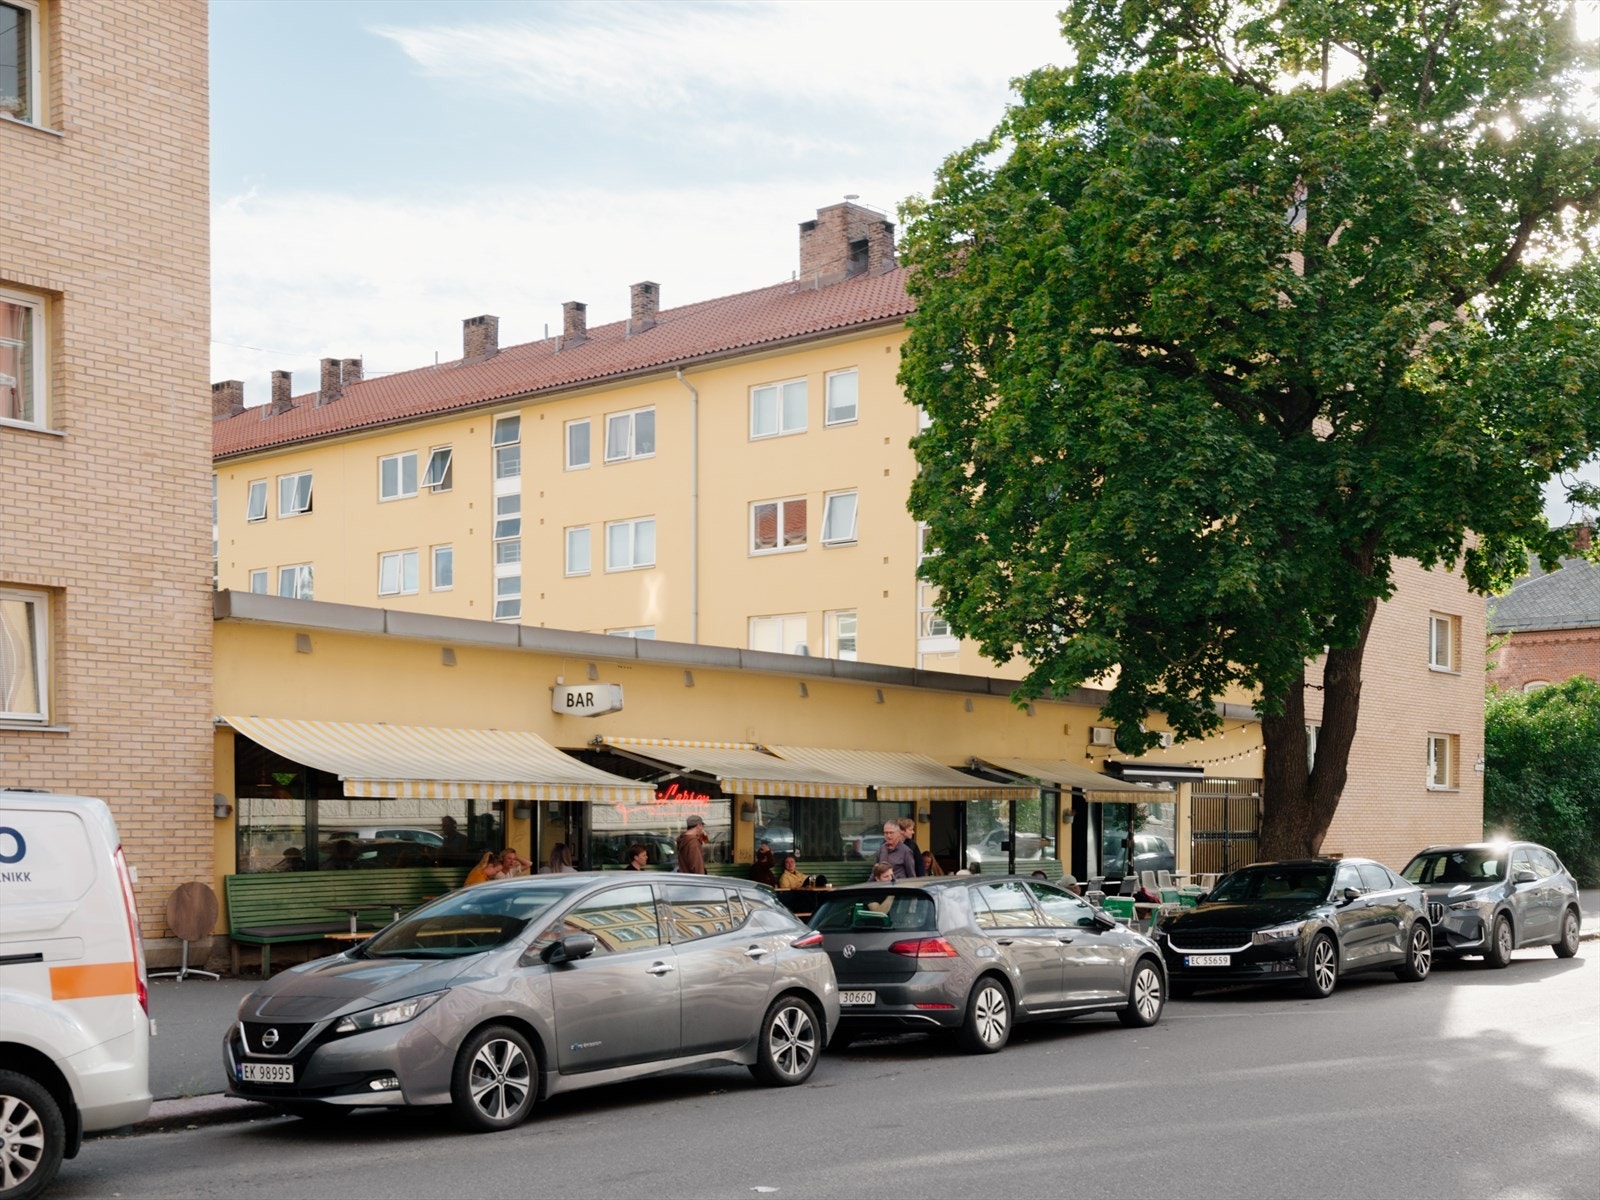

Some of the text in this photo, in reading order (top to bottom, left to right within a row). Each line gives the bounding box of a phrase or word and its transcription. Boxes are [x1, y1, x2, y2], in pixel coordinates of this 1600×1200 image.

[566, 692, 595, 708] BAR
[0, 871, 32, 883] NIKK
[1190, 956, 1229, 965] EC 55659
[843, 992, 872, 1003] 30660
[244, 1065, 291, 1080] EK 98995
